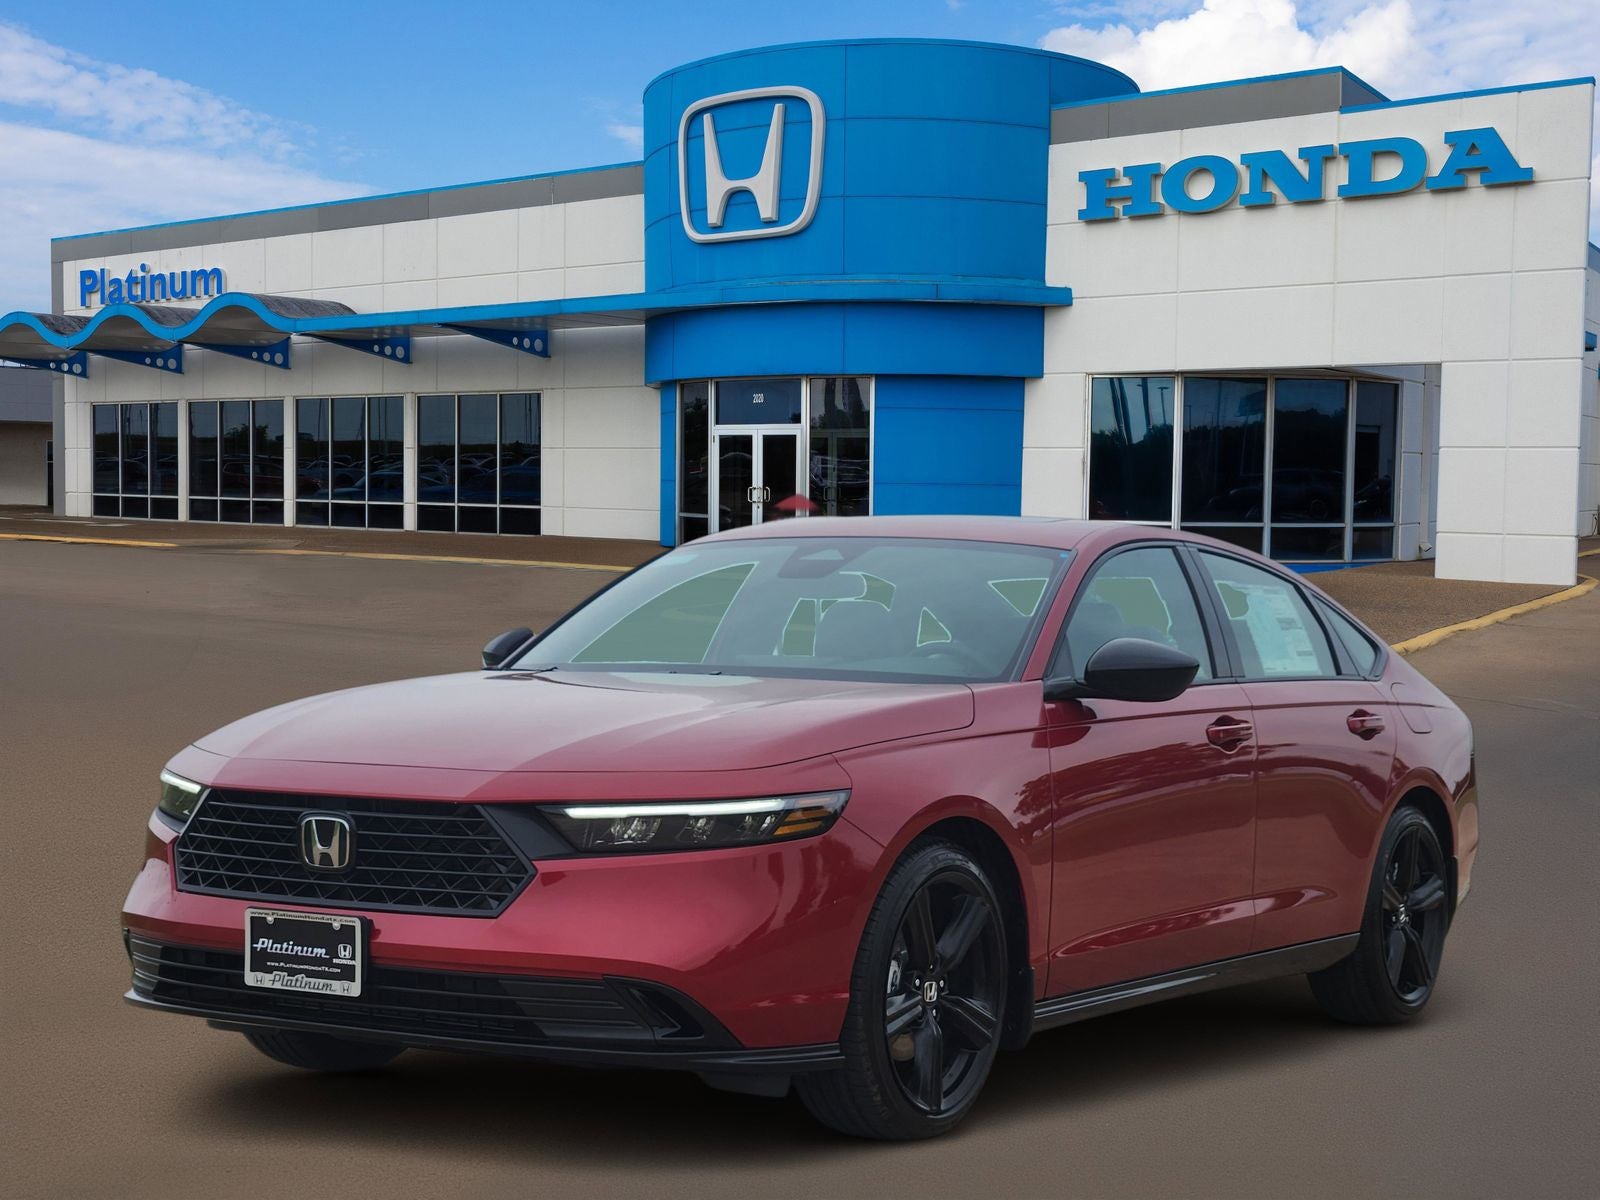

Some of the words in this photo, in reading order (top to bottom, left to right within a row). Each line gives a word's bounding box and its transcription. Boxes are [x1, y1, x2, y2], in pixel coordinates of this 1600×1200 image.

[1078, 126, 1535, 222] HONDA
[79, 262, 225, 308] Platinum
[753, 393, 764, 403] 2020
[253, 938, 330, 958] Platinum
[268, 973, 336, 992] Platinum
